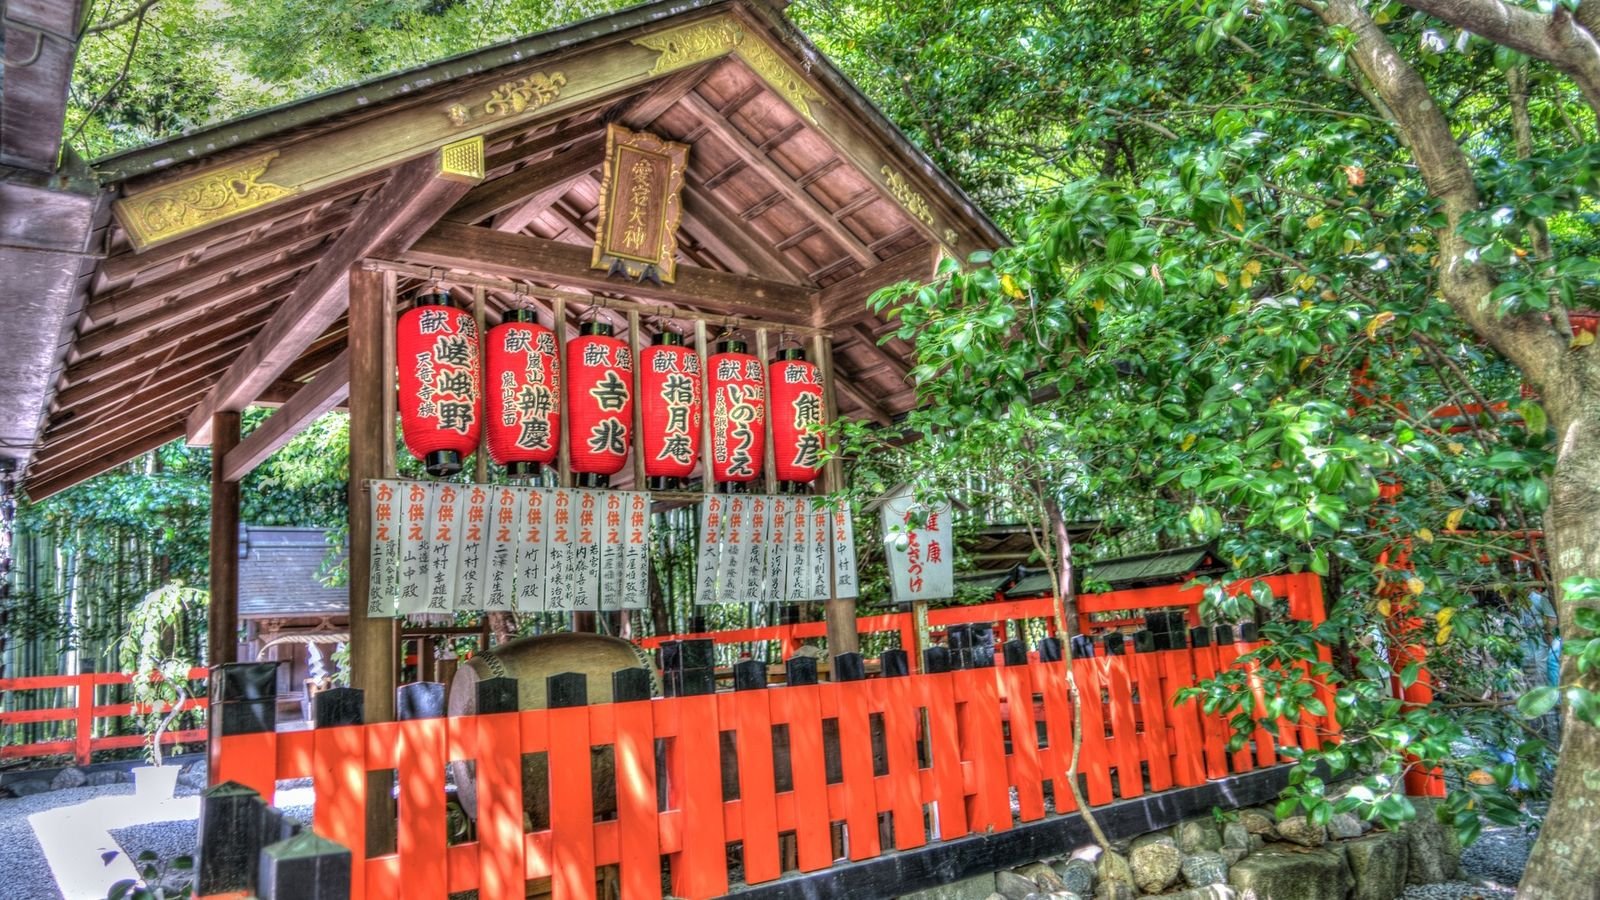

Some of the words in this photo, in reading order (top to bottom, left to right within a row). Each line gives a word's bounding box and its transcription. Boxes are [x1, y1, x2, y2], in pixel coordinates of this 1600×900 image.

[416, 353, 436, 417] 天竜寺横
[433, 336, 475, 435] 嵯峨野
[502, 371, 518, 426] 嵐山正面
[588, 370, 629, 456] 吉兆
[656, 374, 695, 466] 指月庵
[726, 384, 755, 477] いのうえ
[793, 392, 824, 467] 熊彦
[376, 483, 394, 542] お供え
[408, 484, 425, 541] お供え
[436, 485, 456, 542] お供え
[466, 486, 485, 542] お供え
[496, 488, 515, 543] お供え
[526, 490, 542, 543] お供え
[554, 490, 569, 543] お供え
[580, 492, 594, 544] お供え
[607, 493, 620, 544] お供え
[631, 494, 645, 544] お供え
[705, 497, 720, 543] お供え
[728, 497, 743, 543] お供え
[751, 497, 764, 543] お供え
[773, 498, 784, 543] お供え
[794, 498, 805, 543] お供え
[401, 550, 419, 599] 山中殿
[520, 548, 539, 598] 竹村殿
[589, 542, 599, 578] 若宮町
[837, 543, 851, 586] 中村殿
